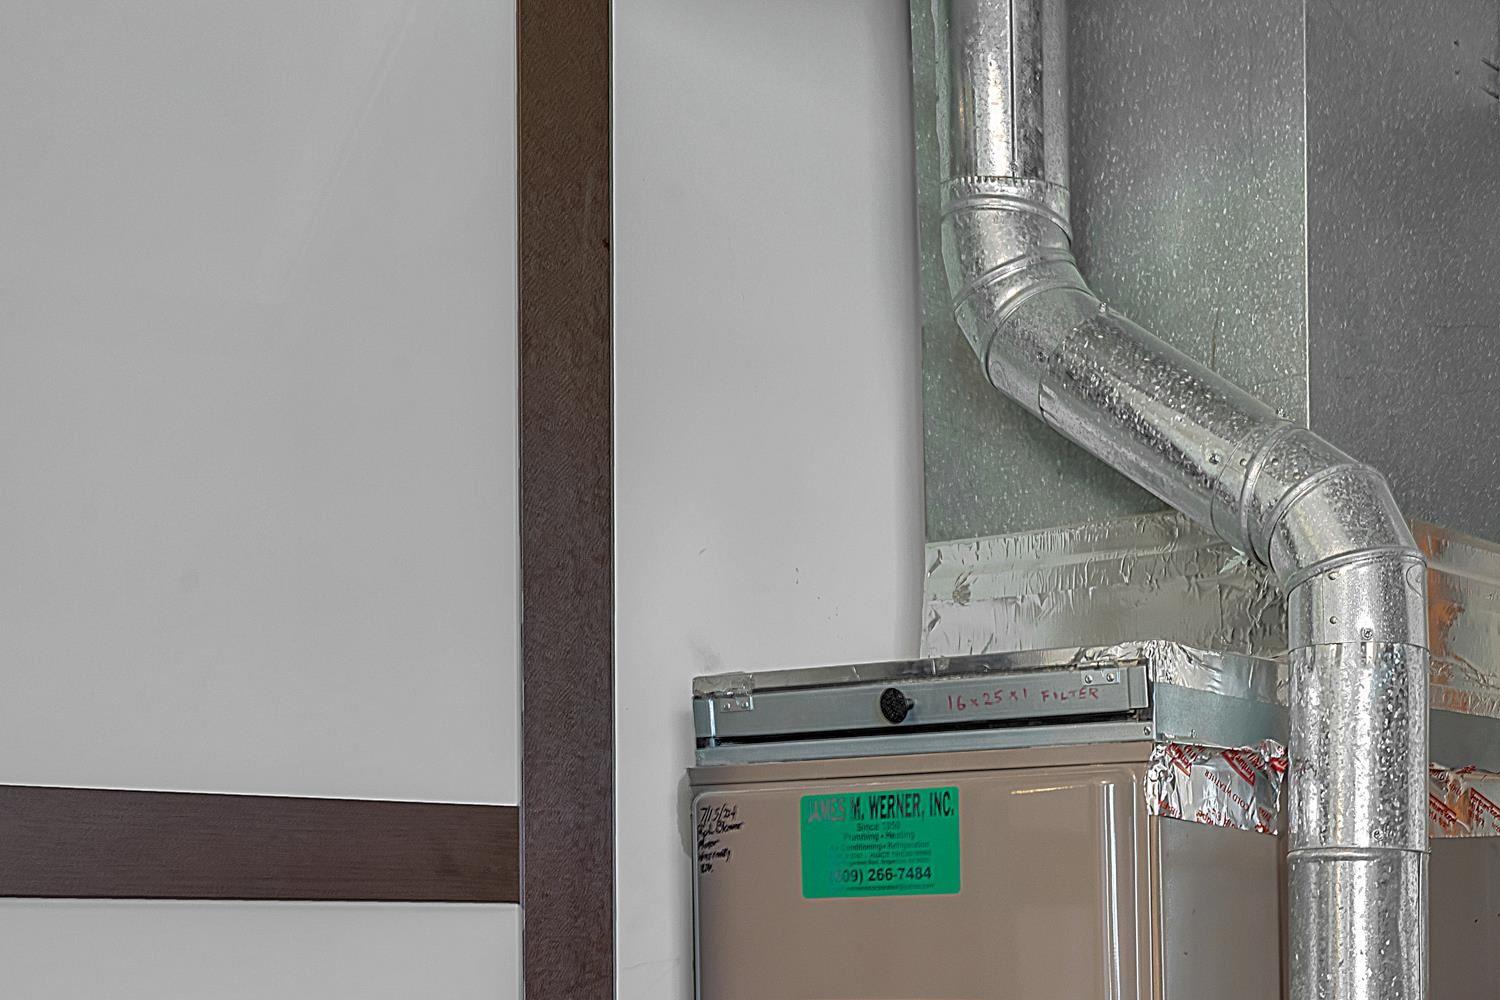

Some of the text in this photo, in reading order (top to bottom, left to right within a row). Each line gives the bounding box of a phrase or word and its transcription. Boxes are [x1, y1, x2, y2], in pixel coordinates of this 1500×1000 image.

[1041, 688, 1098, 701] FILTER
[869, 793, 926, 820] WERNER,
[929, 791, 955, 816] INC.
[868, 866, 932, 882] 266-7484
